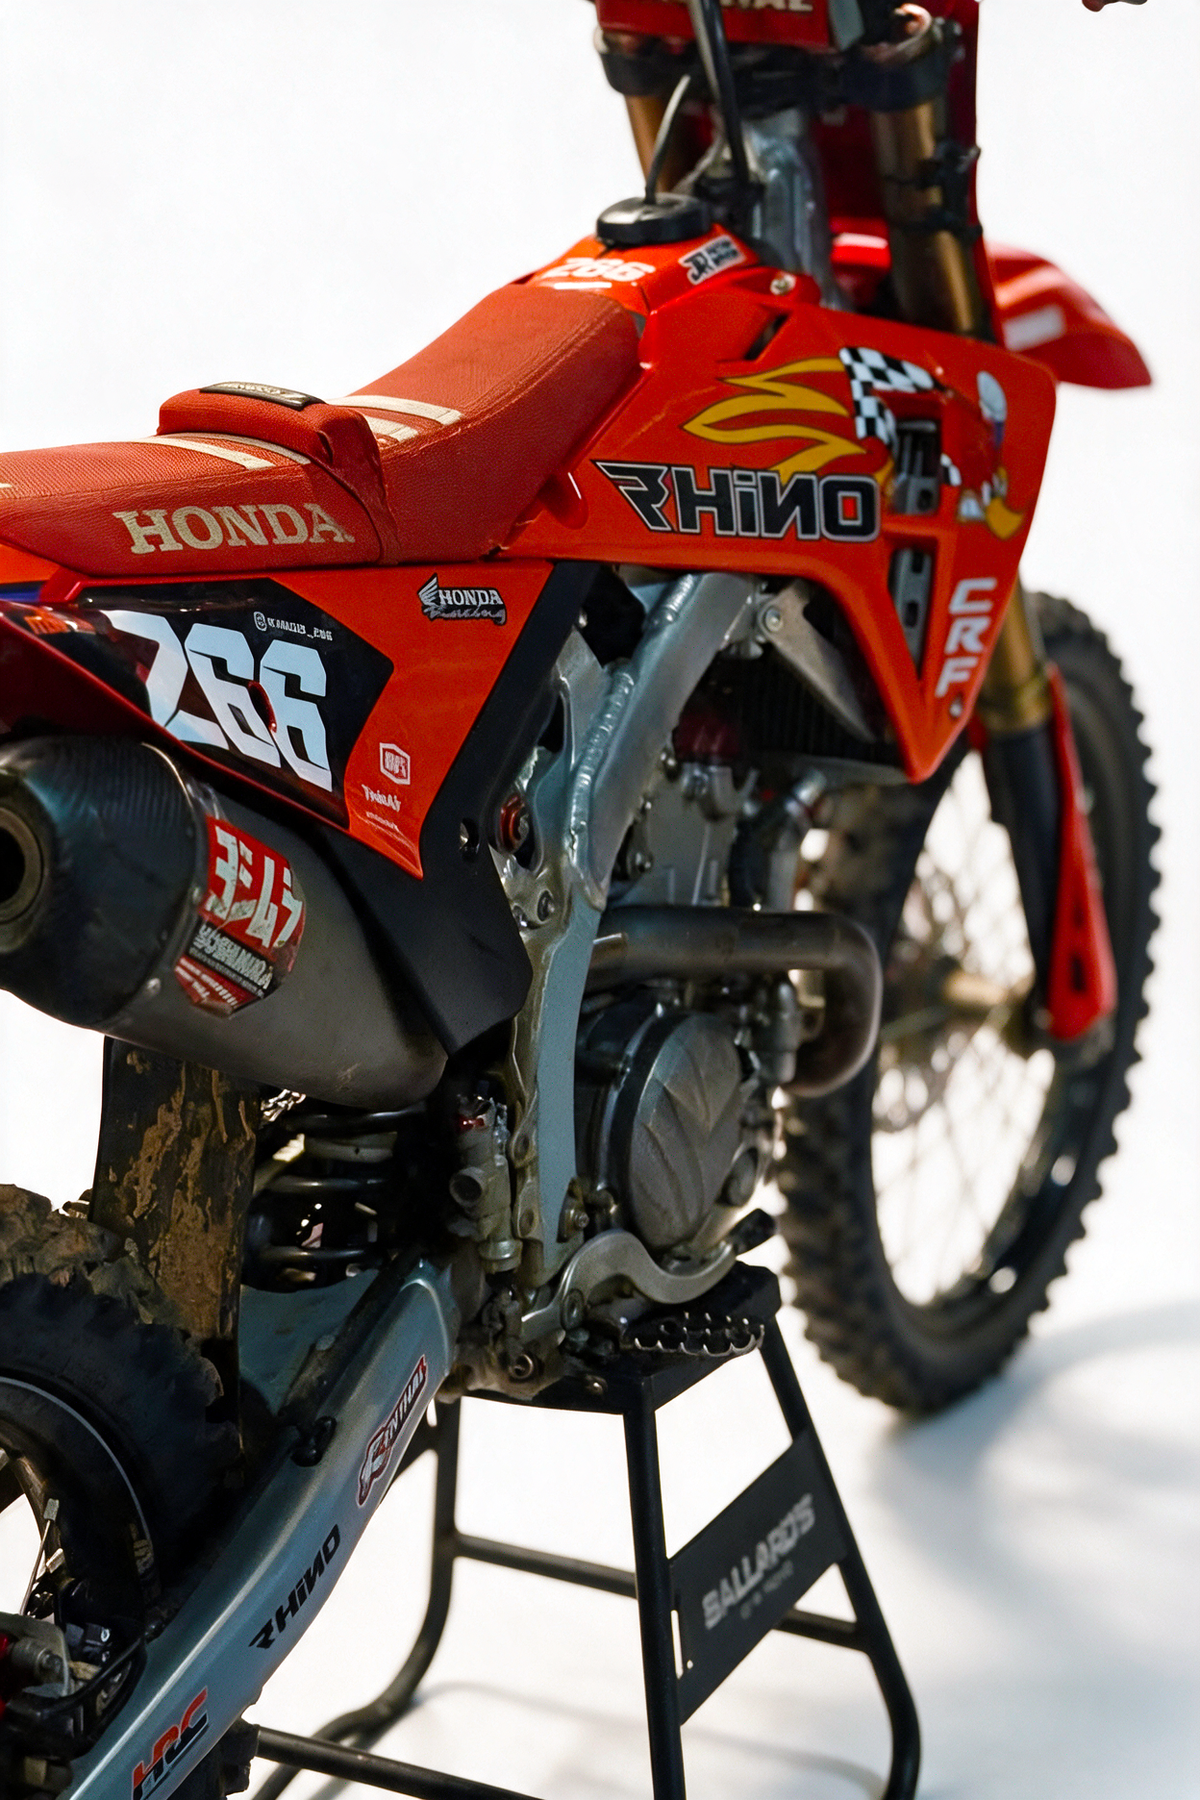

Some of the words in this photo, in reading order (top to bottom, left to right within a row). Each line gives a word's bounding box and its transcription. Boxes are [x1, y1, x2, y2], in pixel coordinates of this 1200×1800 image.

[113, 503, 355, 554] HONDA
[438, 589, 504, 605] HONDA
[935, 577, 997, 698] CRF
[131, 1687, 209, 1800] HRC
